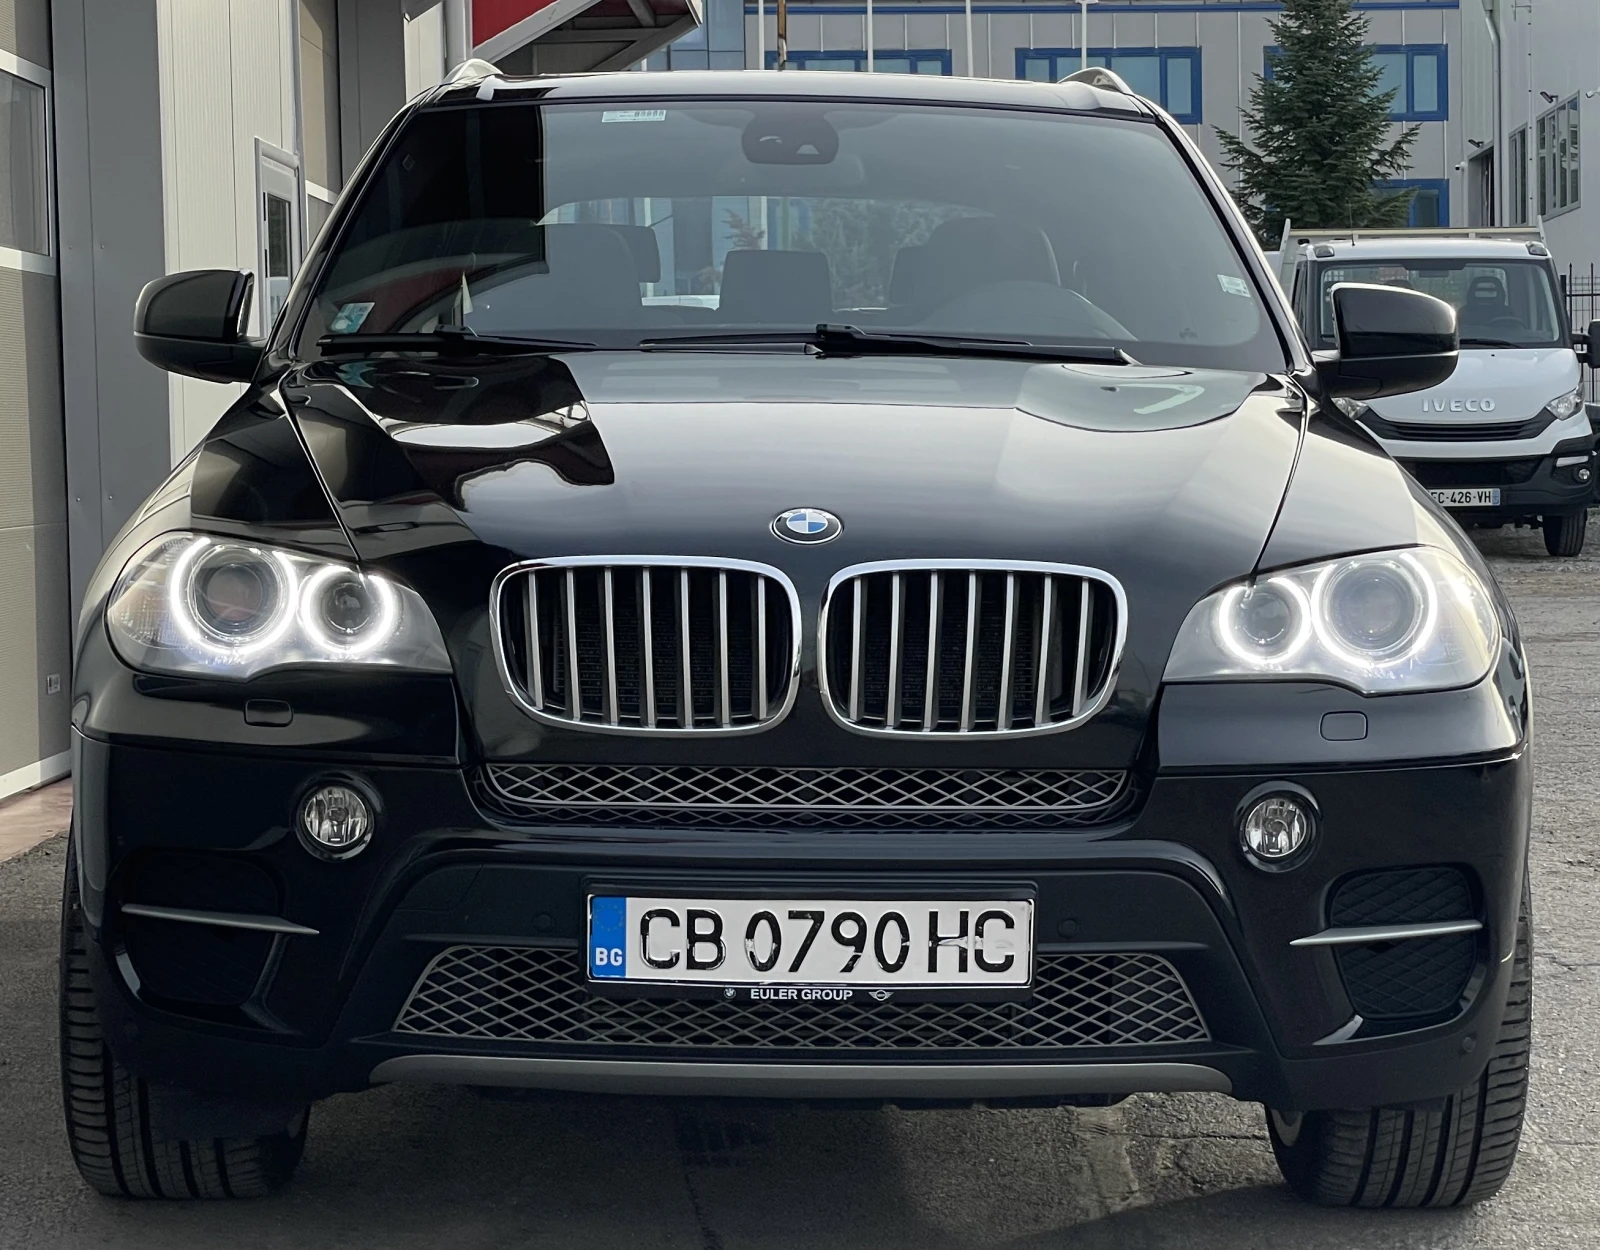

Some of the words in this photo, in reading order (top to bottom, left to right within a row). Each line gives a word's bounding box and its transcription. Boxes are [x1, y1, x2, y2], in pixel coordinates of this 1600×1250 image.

[1422, 397, 1496, 413] IVECO
[640, 908, 726, 970] CB
[744, 910, 910, 973] 0790
[928, 910, 1015, 974] HC
[595, 948, 623, 967] BG
[750, 988, 798, 1000] EULER
[801, 988, 853, 1001] GROUP
